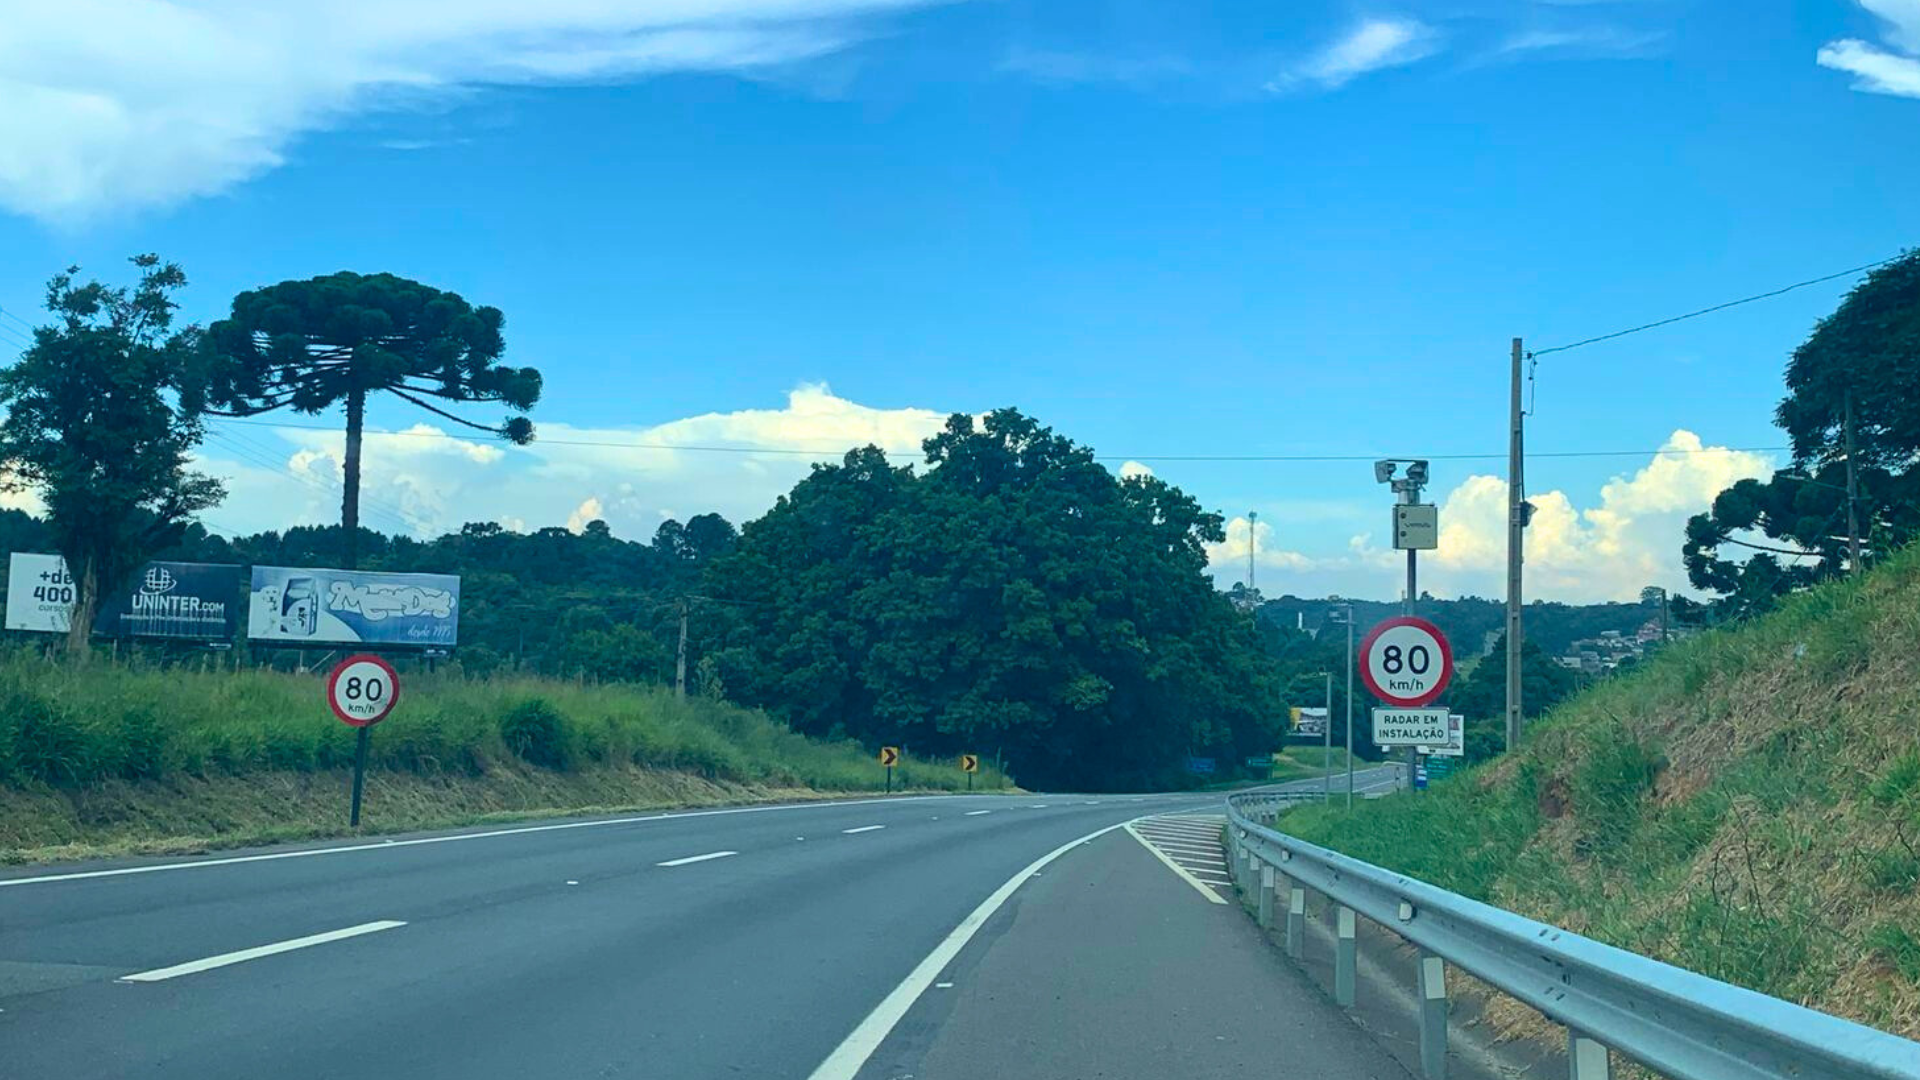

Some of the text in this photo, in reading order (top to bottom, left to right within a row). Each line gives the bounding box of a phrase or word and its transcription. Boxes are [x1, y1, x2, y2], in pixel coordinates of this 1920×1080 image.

[33, 586, 73, 604] 400
[1383, 645, 1430, 674] 80
[346, 677, 382, 701] 80
[1389, 678, 1424, 691] km/h
[348, 704, 375, 713] km/h
[1384, 715, 1438, 724] RADAR EM
[1379, 727, 1444, 740] INSTALAÇÃO
